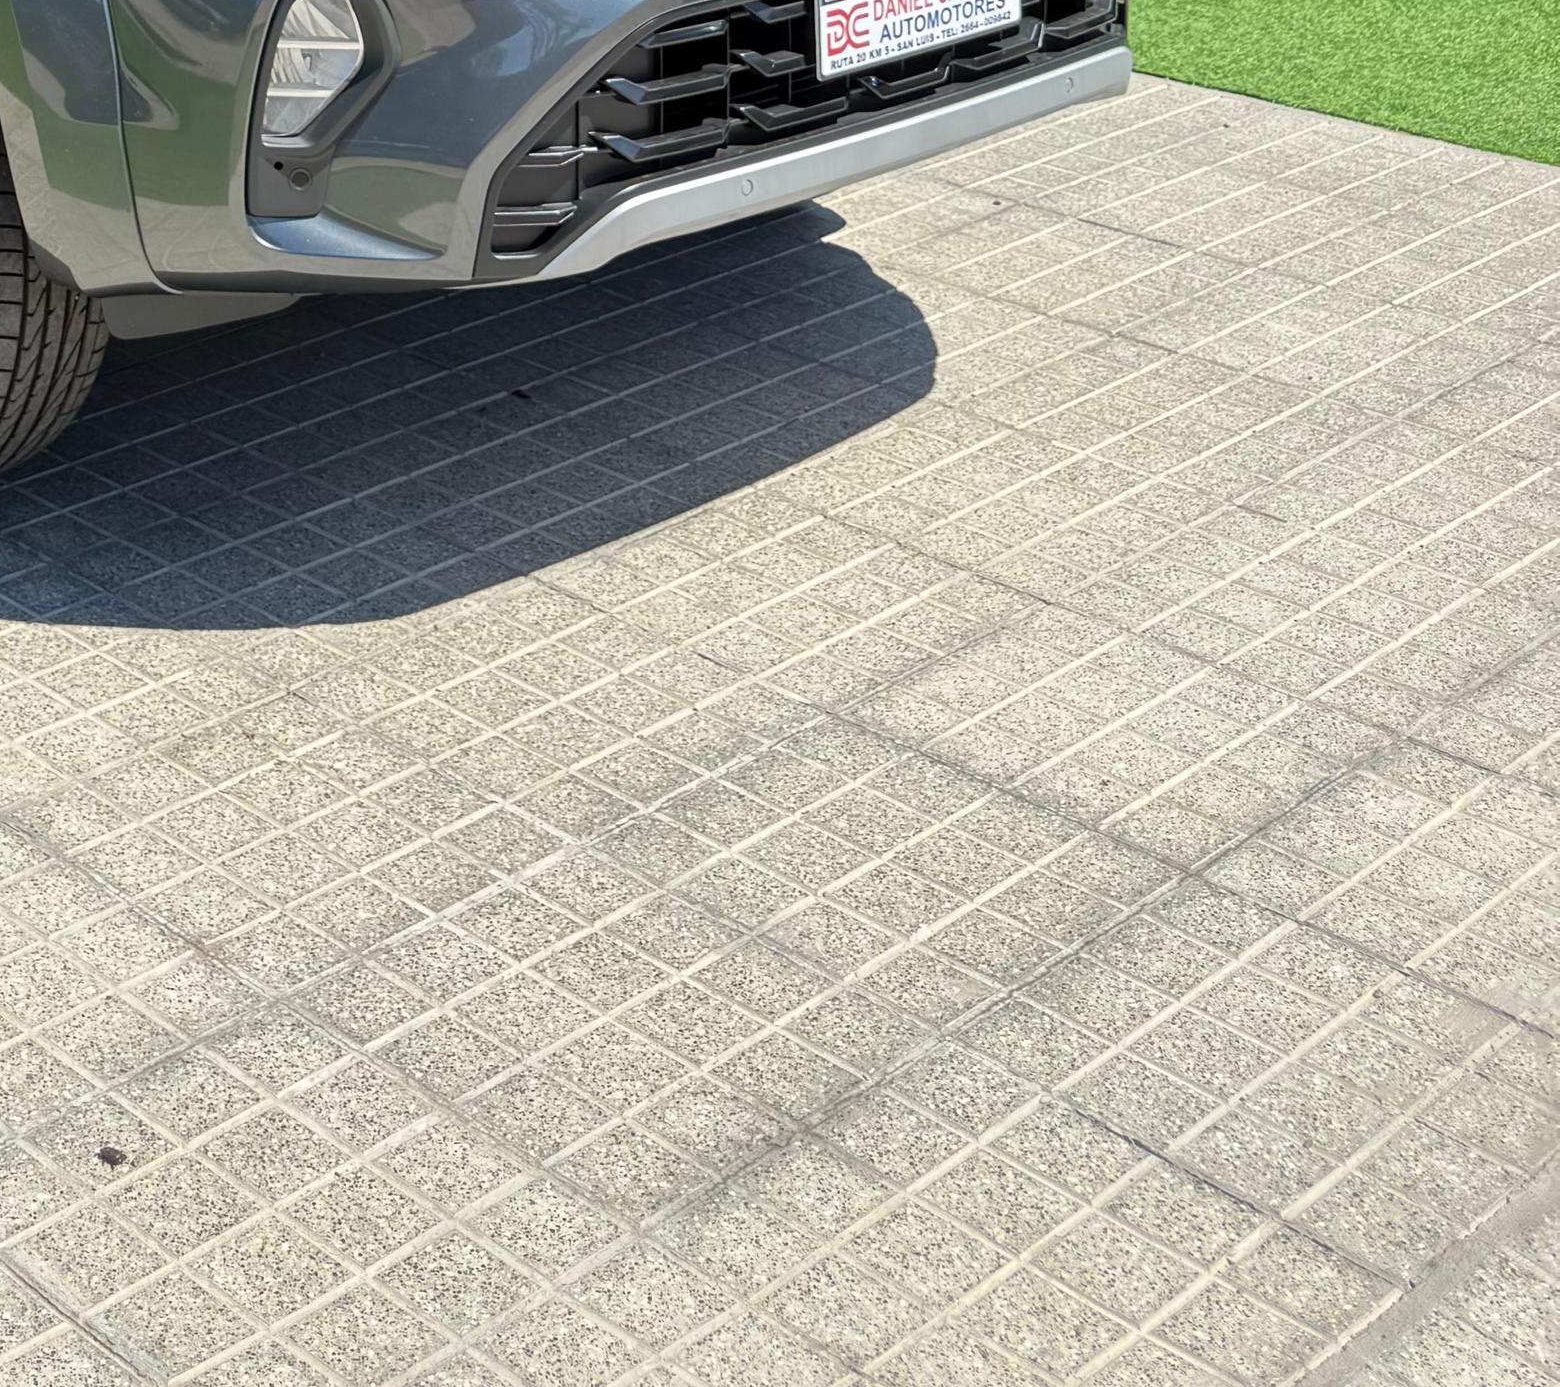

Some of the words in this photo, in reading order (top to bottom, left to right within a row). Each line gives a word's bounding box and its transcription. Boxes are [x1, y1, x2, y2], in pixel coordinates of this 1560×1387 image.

[830, 56, 854, 69] RUTA
[869, 47, 882, 59] KM
[897, 38, 913, 52] SAN
[916, 33, 934, 46] LUIS
